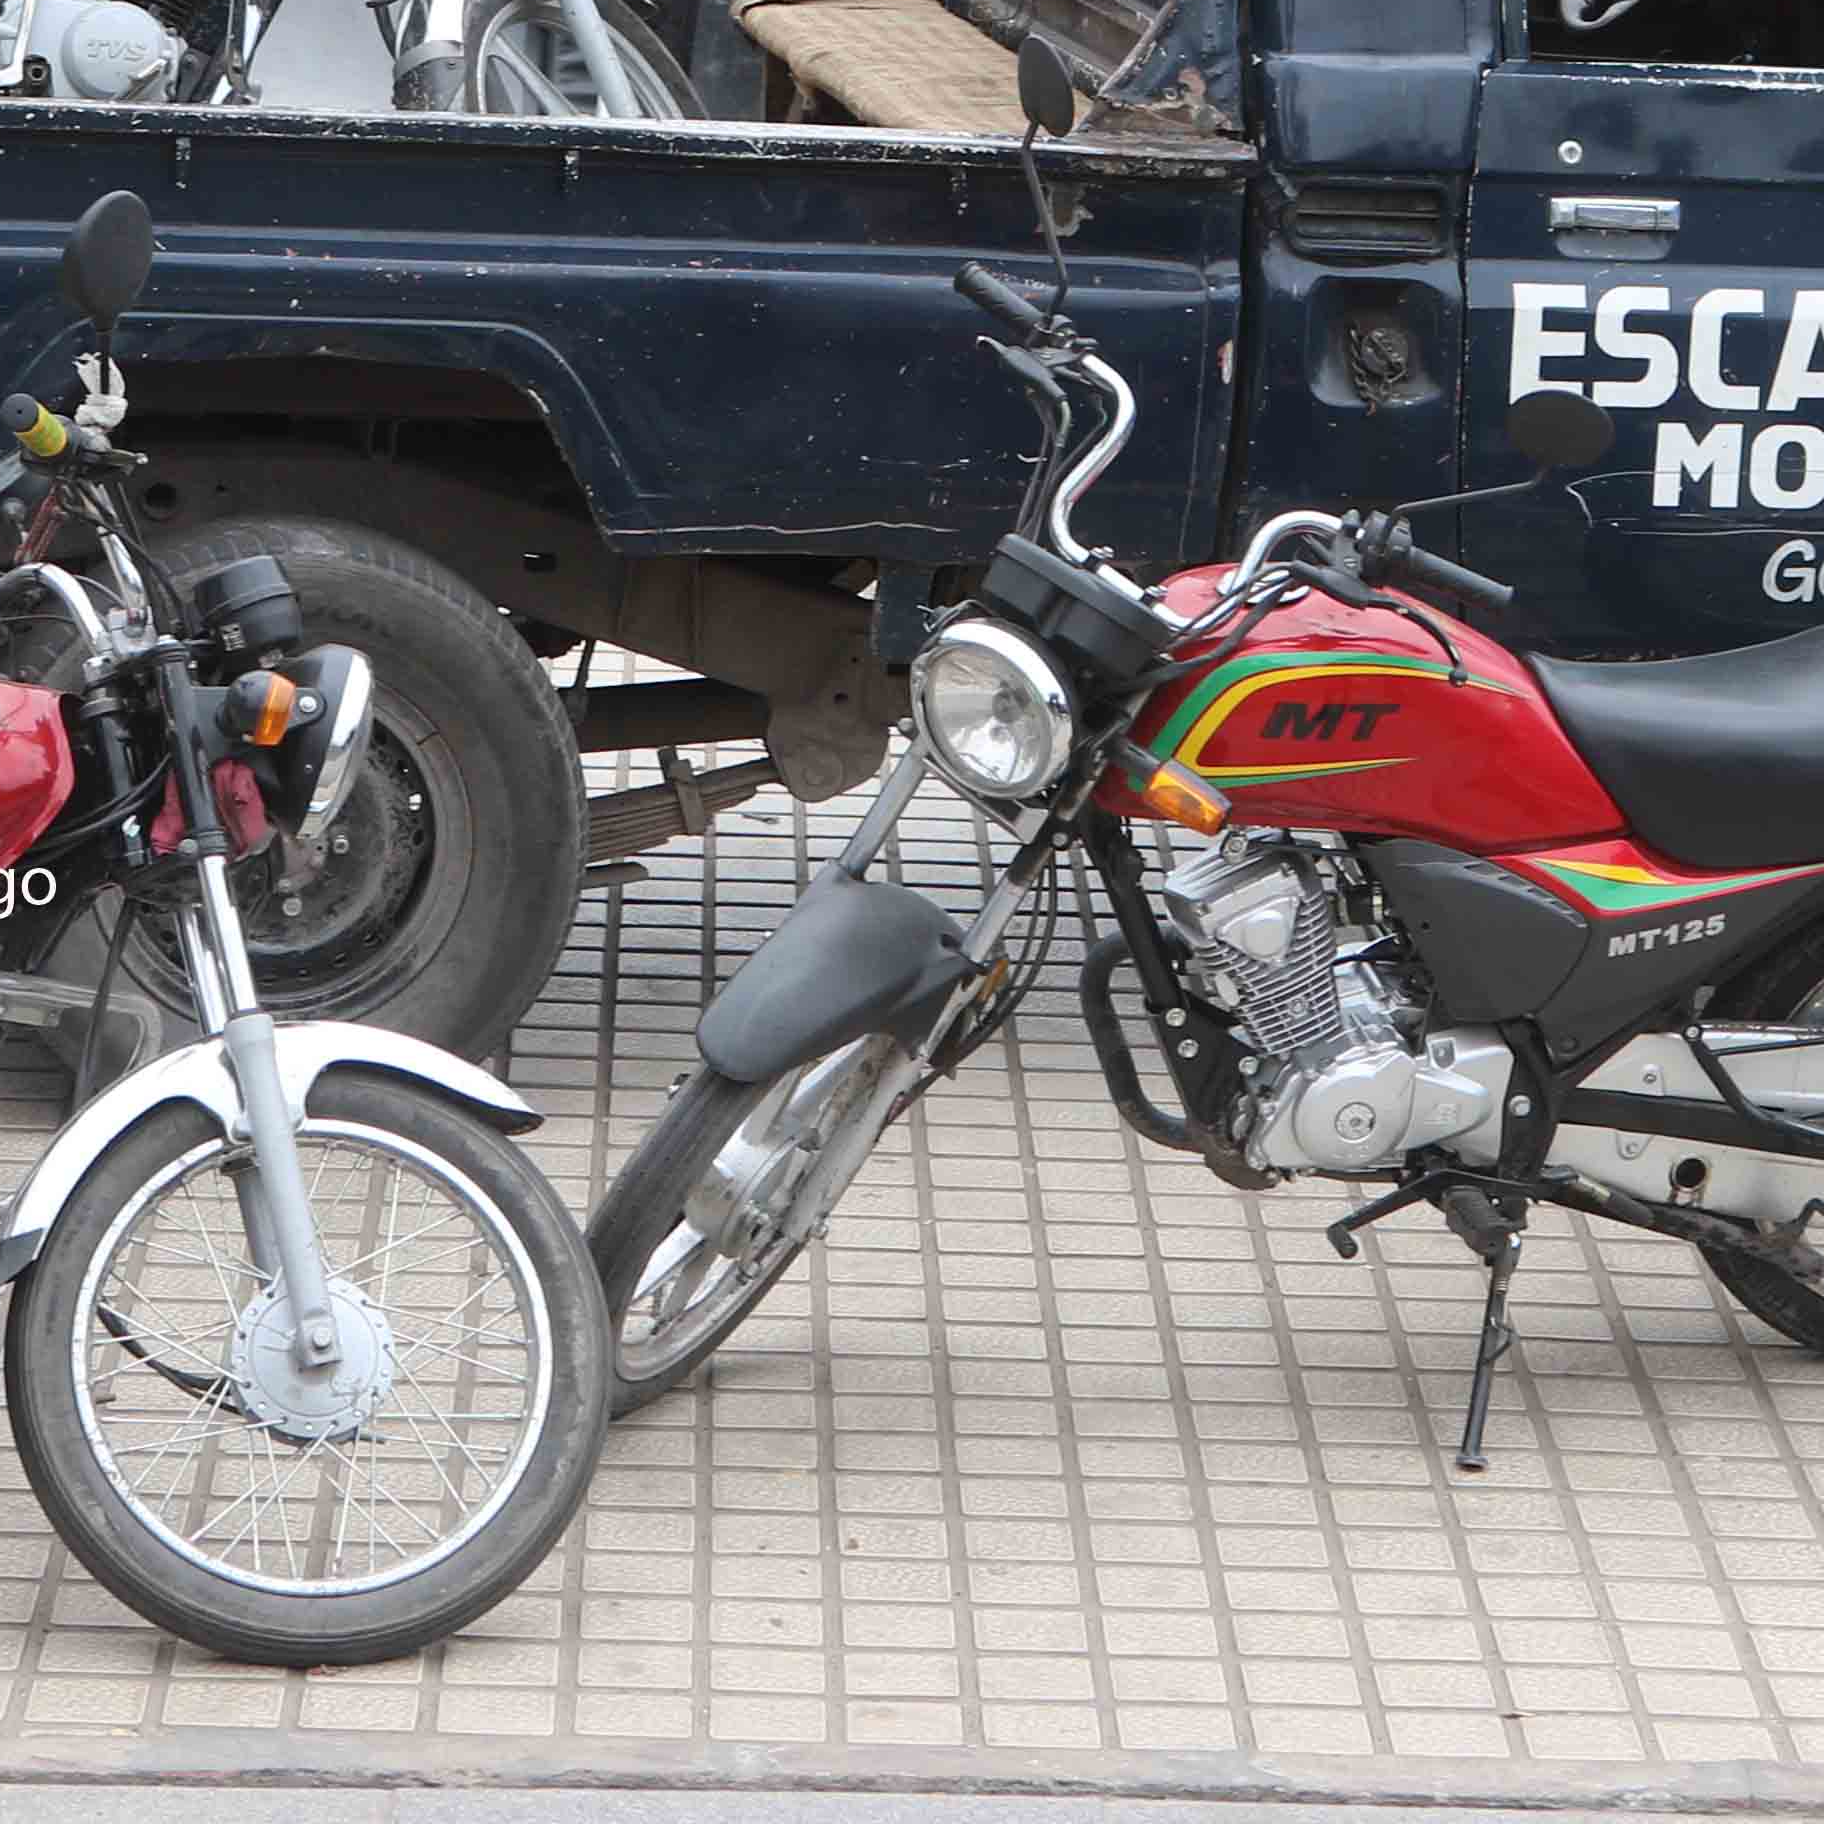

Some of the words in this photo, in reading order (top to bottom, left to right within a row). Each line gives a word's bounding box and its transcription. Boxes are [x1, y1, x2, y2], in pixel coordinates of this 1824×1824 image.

[87, 39, 147, 63] TVS
[1260, 702, 1402, 742] MT
[1607, 913, 1726, 958] MT125
